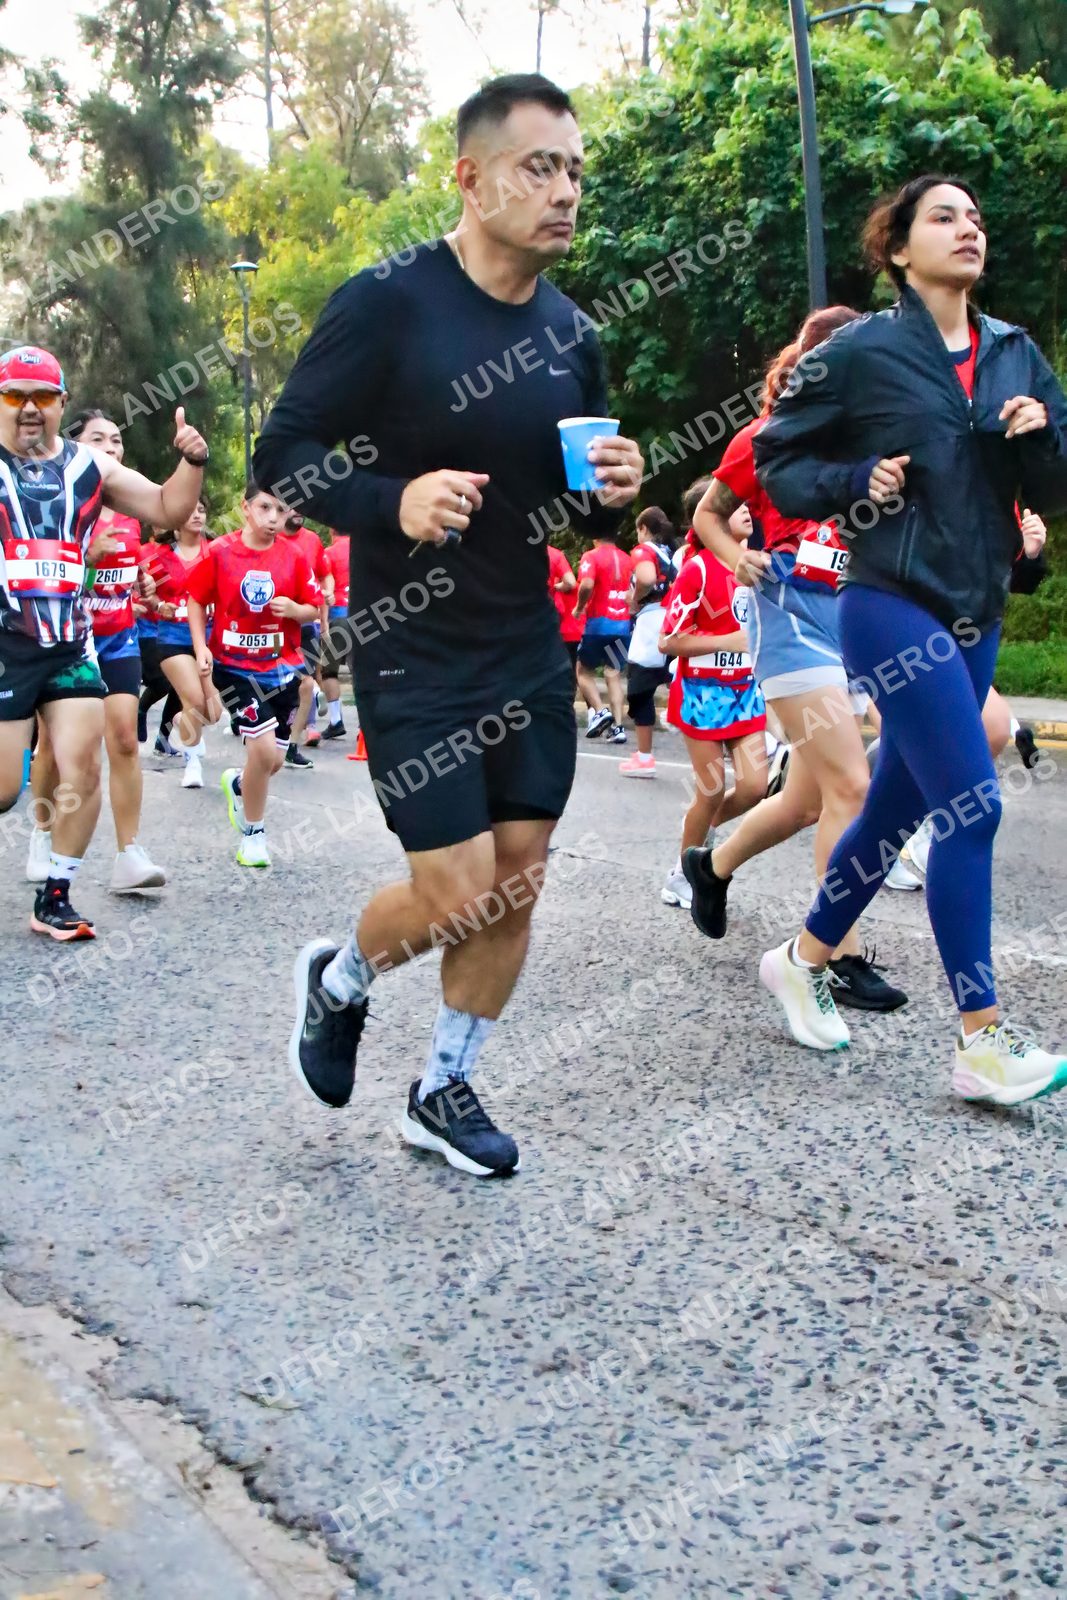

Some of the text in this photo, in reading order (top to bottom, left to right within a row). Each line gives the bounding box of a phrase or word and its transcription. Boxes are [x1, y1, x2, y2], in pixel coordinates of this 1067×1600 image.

[35, 561, 66, 578] 1679
[96, 569, 123, 583] 2601
[82, 597, 129, 611] ANTIAGO
[239, 634, 268, 647] 2053
[714, 651, 743, 667] 1644
